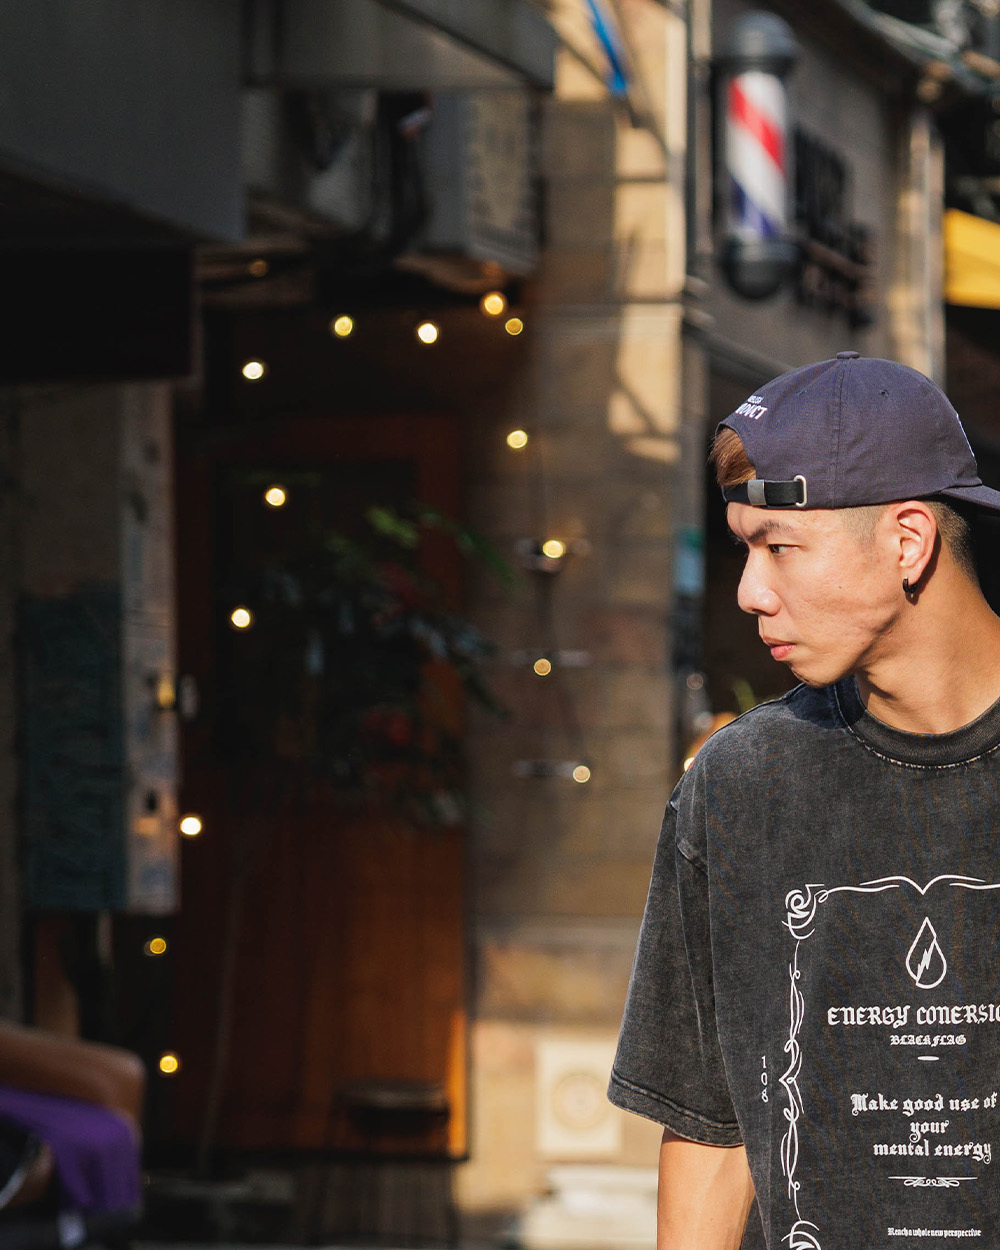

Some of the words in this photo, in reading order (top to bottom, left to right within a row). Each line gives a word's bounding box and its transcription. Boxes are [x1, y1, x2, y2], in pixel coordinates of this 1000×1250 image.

[827, 1005, 911, 1029] ENERGY
[850, 1093, 899, 1116] Make
[902, 1093, 944, 1117] good
[949, 1099, 980, 1112] use
[983, 1091, 998, 1109] of
[909, 1119, 950, 1143] your
[873, 1139, 930, 1157] mental
[933, 1141, 992, 1165] energy
